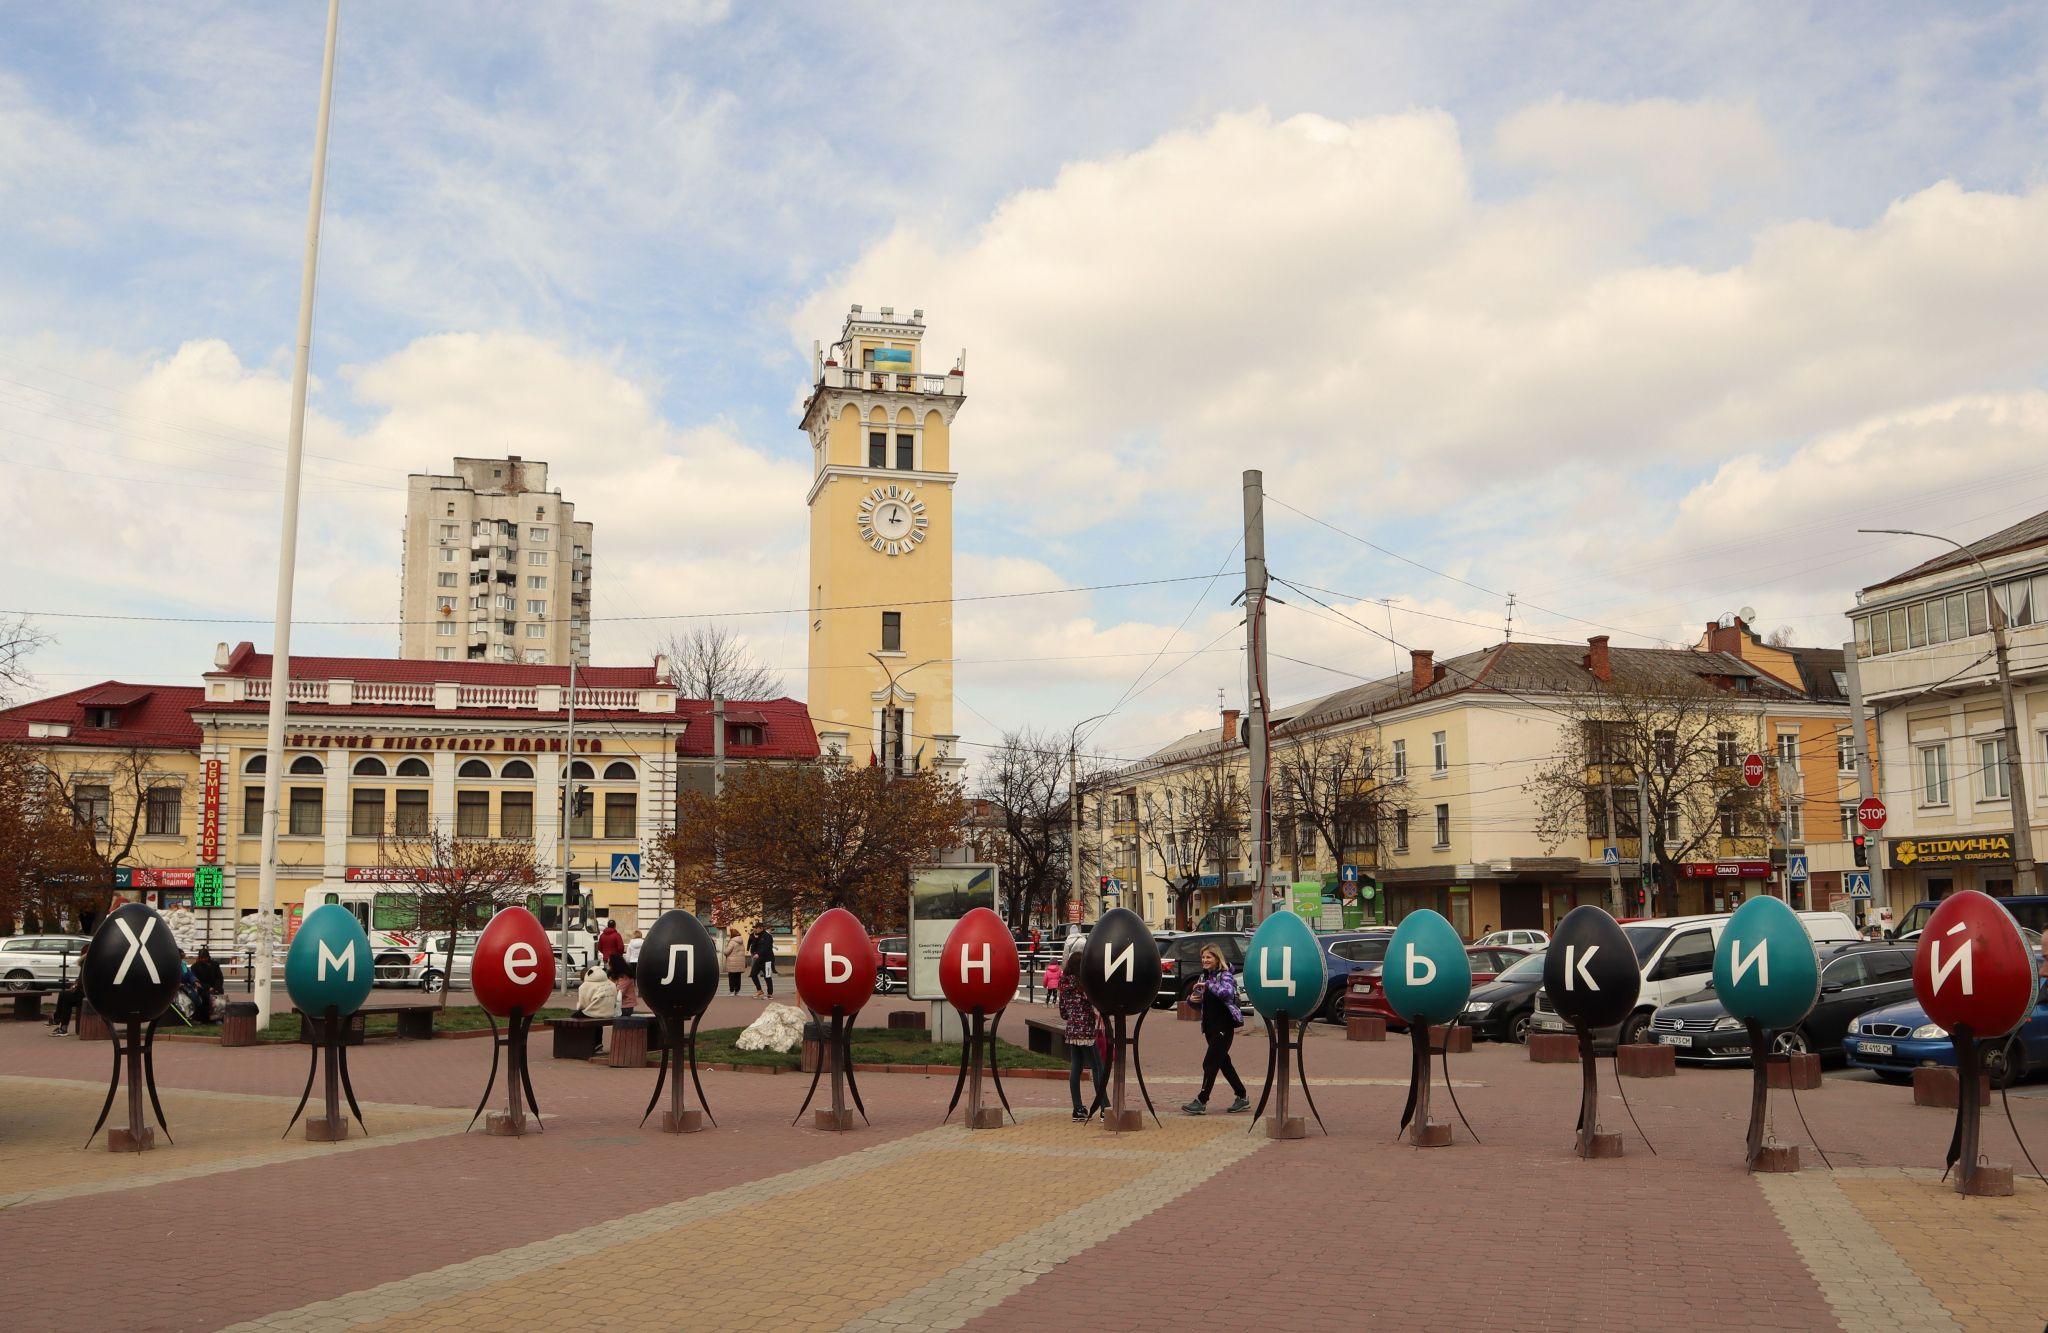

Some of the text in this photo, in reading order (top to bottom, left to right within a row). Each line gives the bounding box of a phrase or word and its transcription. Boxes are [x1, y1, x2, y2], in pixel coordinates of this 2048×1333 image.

[283, 734, 373, 748] ИТЯЧИЙ
[1745, 765, 1763, 776] STOP
[205, 761, 218, 855] ОБМІН ВАЛЮТ
[1859, 808, 1886, 820] STOP
[1917, 837, 2010, 854] СТОЛИЧНА
[1918, 851, 2011, 863] ЮВЕЛІРНА ФАБРИКА
